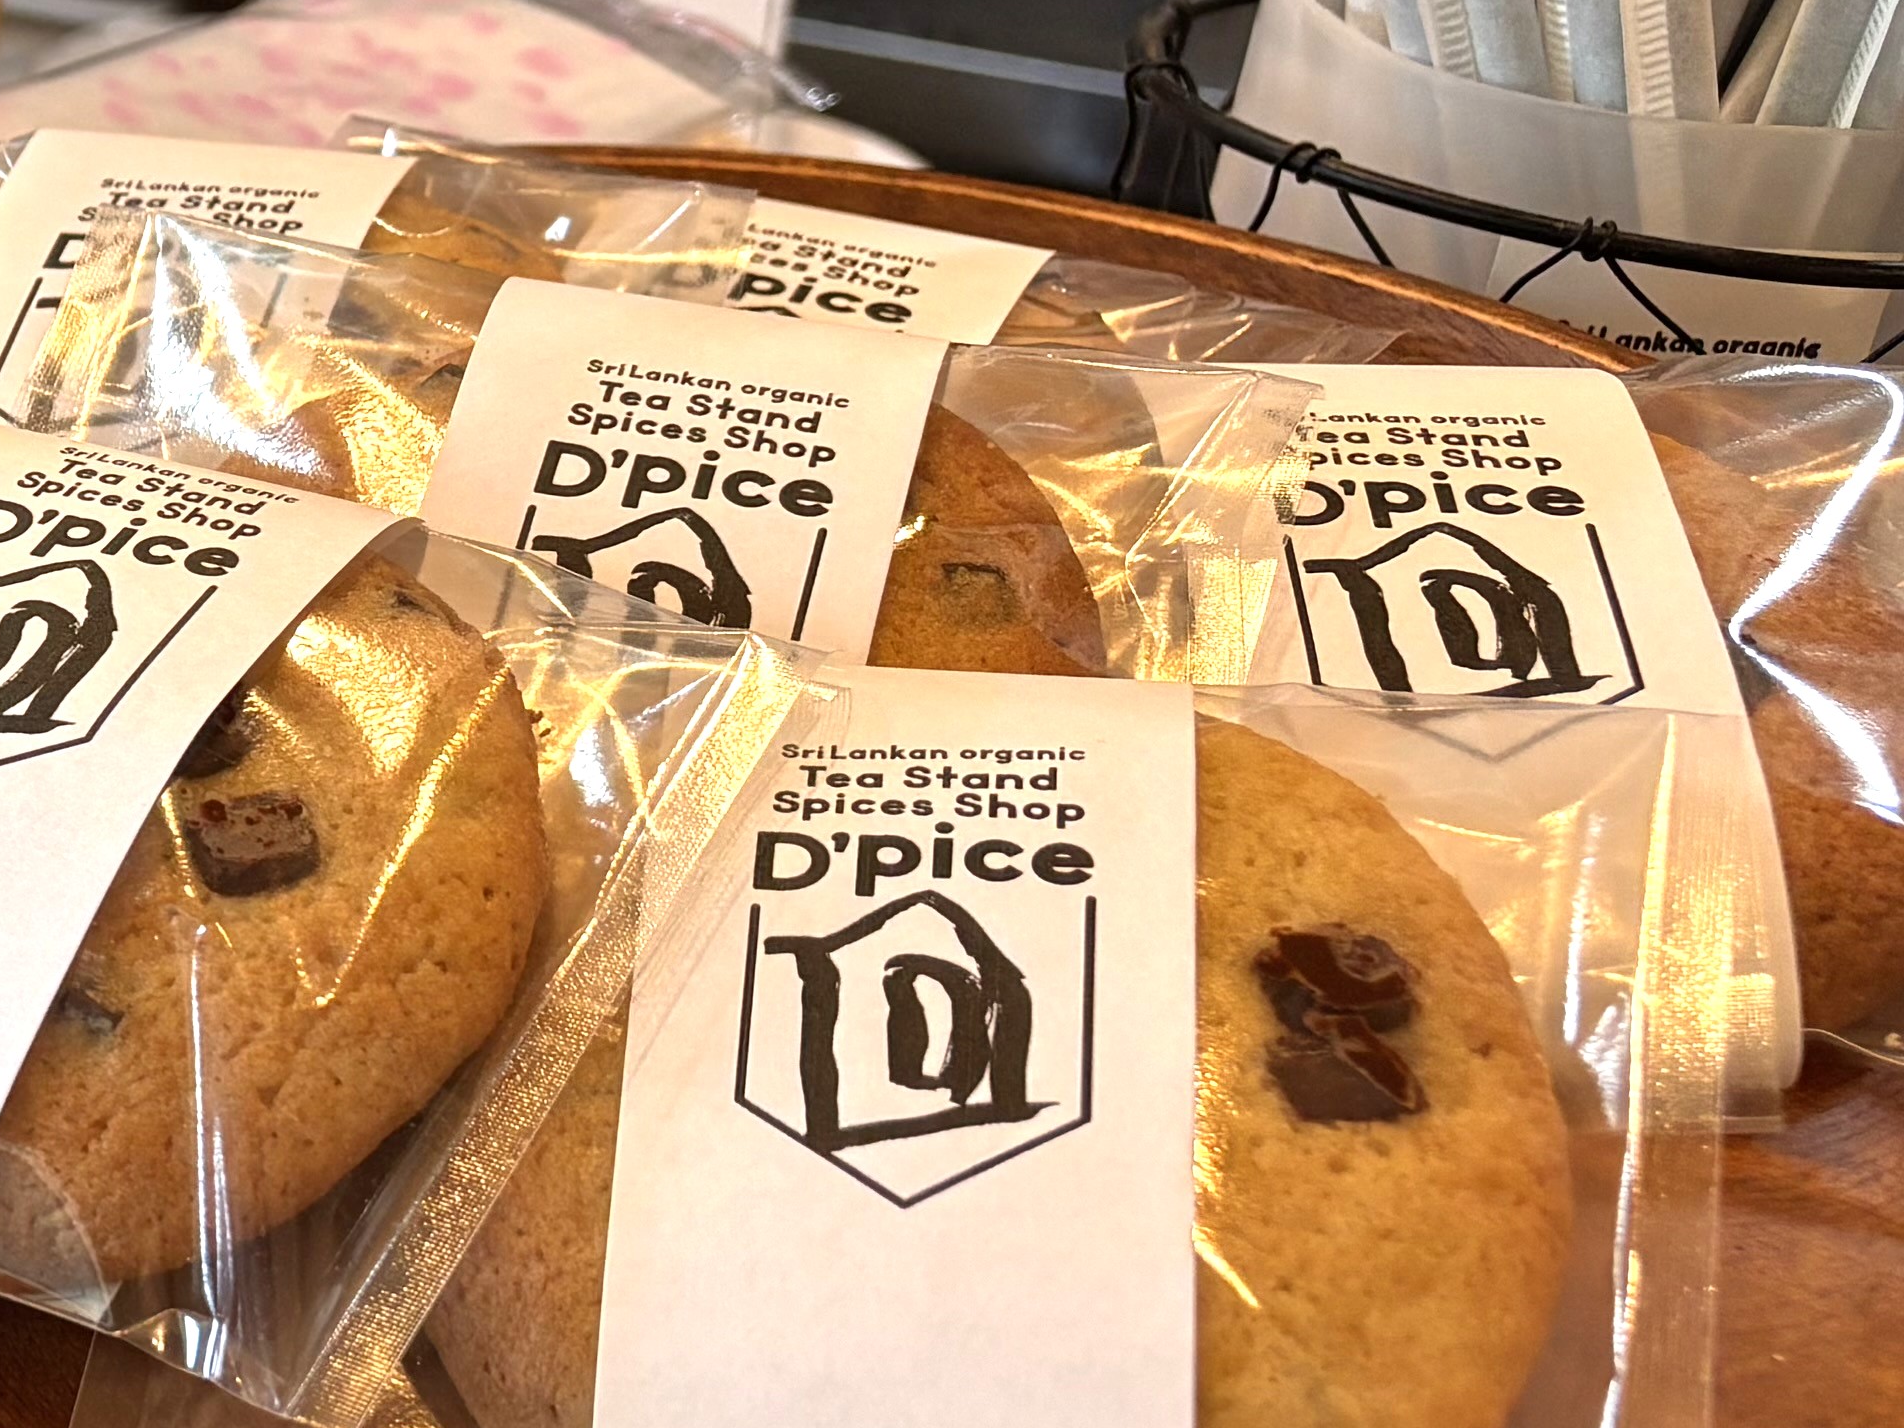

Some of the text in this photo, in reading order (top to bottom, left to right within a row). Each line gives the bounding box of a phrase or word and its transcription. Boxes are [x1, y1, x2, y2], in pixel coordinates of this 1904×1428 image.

[178, 193, 295, 216] Stand
[212, 211, 306, 235] Shop
[792, 244, 912, 279] Stand
[822, 265, 920, 298] Shop
[727, 272, 913, 324] pice
[587, 357, 851, 410] SriLankan organic
[598, 380, 822, 436] Tea Stand
[1430, 413, 1547, 430] organic
[566, 401, 838, 467] Spices Shop
[1387, 425, 1530, 449] Stand
[59, 445, 301, 506] SriLankan organic
[532, 439, 835, 518] D'pice
[1309, 448, 1563, 477] pices Shop
[16, 469, 264, 541] Spices Shop
[57, 458, 269, 518] Tea Stand
[1275, 471, 1586, 529] D'pice
[781, 742, 1087, 766] SriLankan organic
[799, 765, 1058, 792] Tea Stand
[772, 790, 1087, 829] Spices Shop
[752, 822, 1096, 897] D'pice
